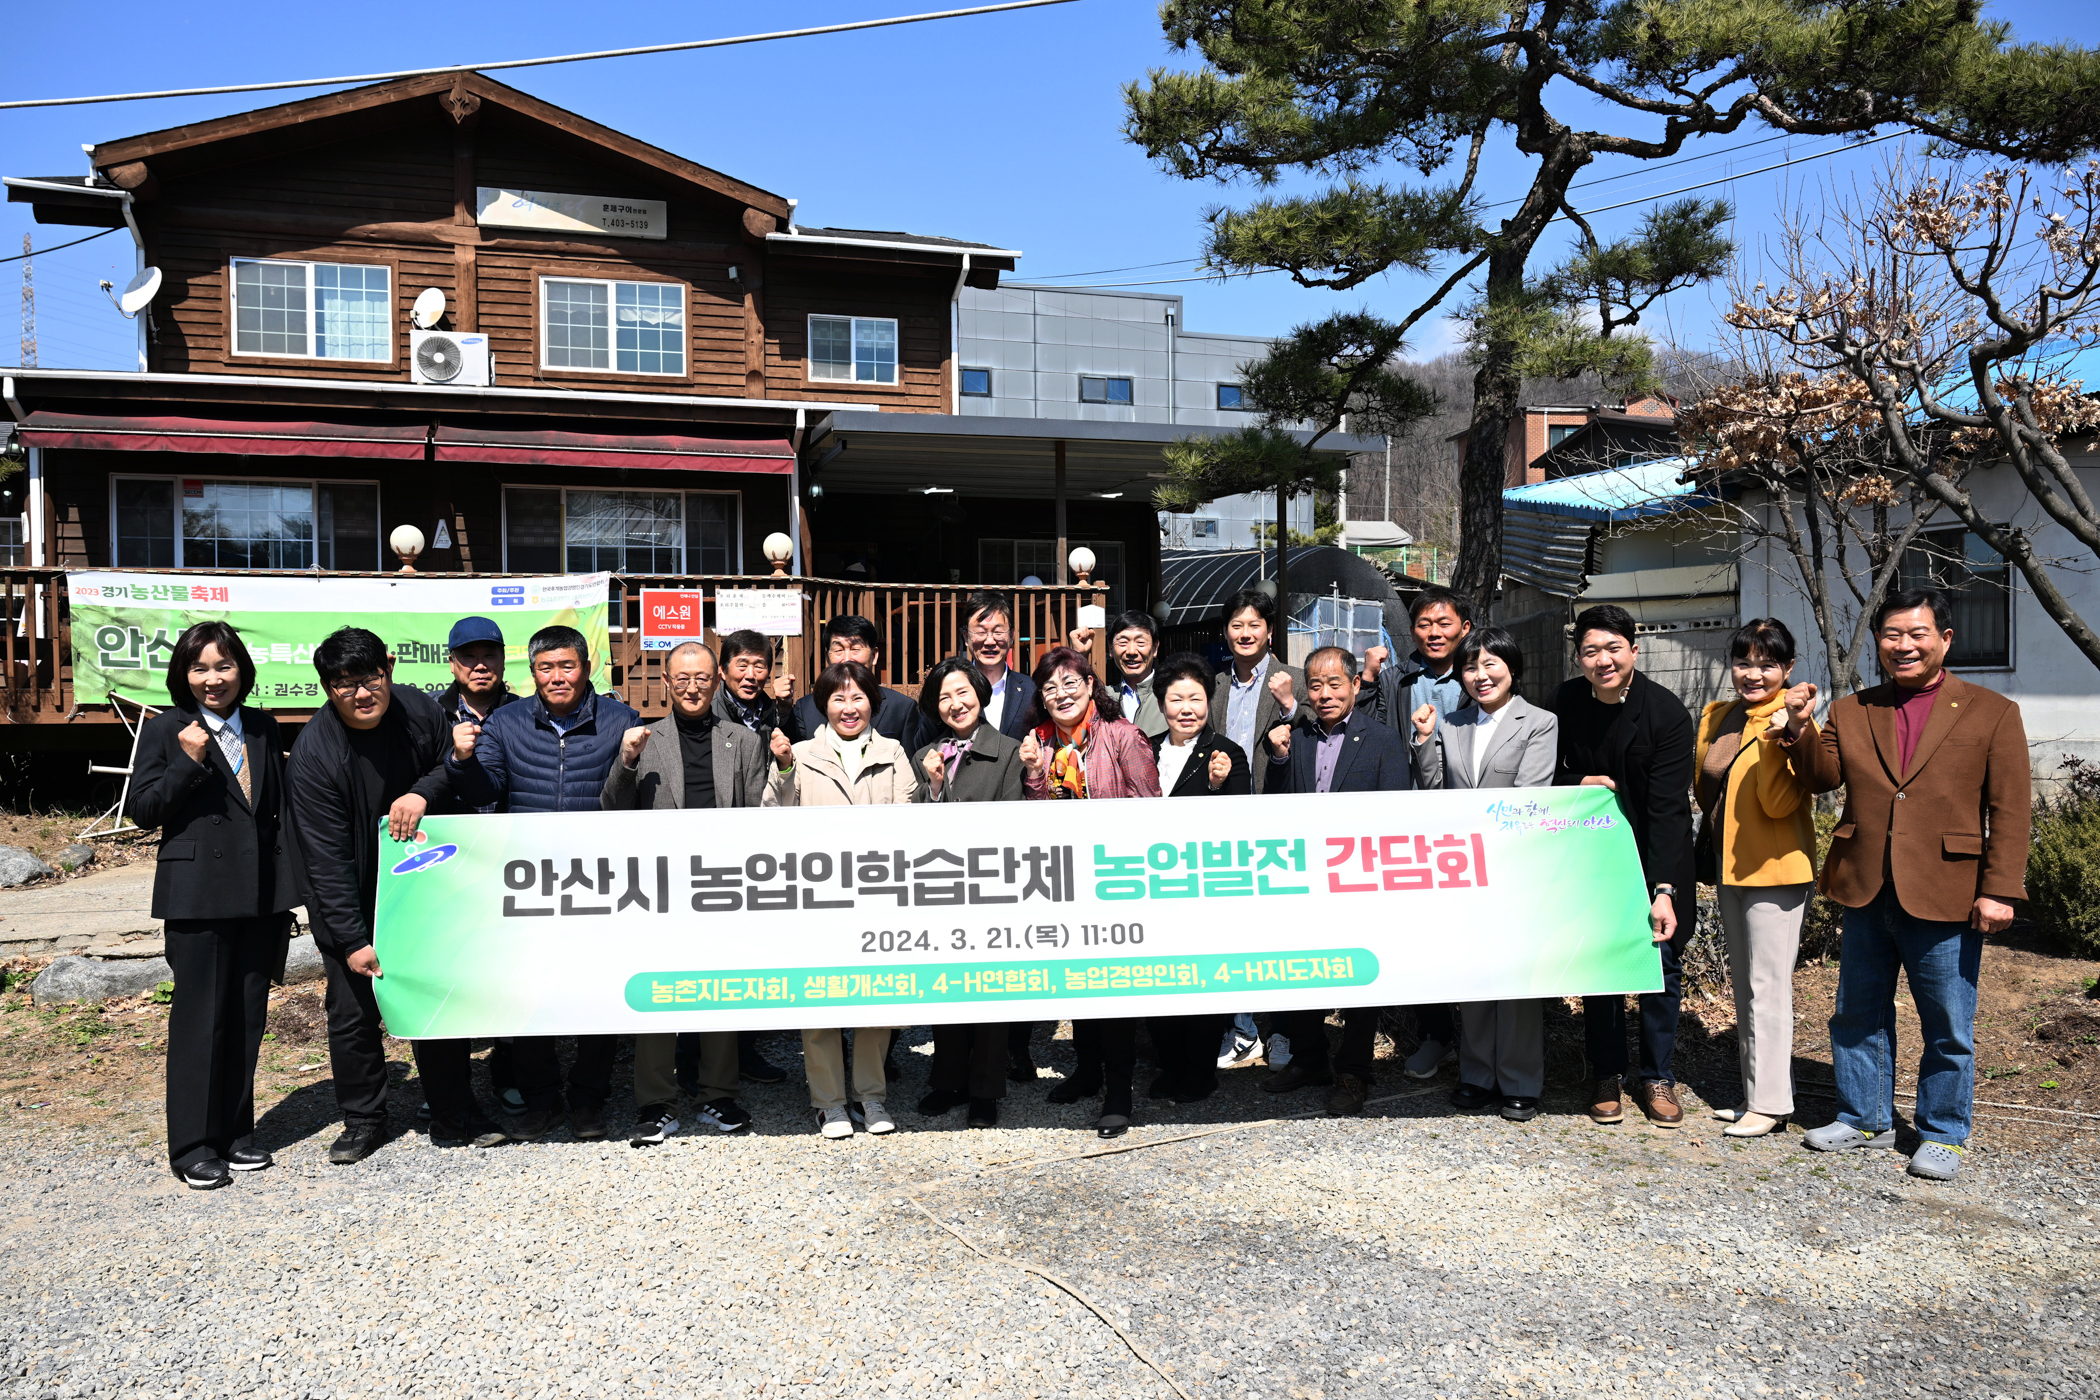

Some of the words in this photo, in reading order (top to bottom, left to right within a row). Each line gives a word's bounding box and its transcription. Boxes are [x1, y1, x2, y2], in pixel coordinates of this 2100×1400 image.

[602, 217, 649, 229] T.403-5139
[75, 587, 99, 596] 2023
[101, 586, 128, 598] 경기
[130, 584, 189, 602] 농산물
[190, 585, 229, 603] 축제
[653, 605, 691, 620] 에스원
[643, 640, 672, 649] SECOM
[274, 683, 318, 696] 권수경
[1582, 814, 1617, 830] 안산
[502, 855, 669, 918] 안산시
[690, 845, 1075, 913] 농업인학습단체
[1093, 838, 1310, 901] 농업발전
[1325, 833, 1489, 893] 간담회
[861, 930, 939, 953] 2024.
[950, 928, 976, 951] 3.
[986, 923, 1070, 949] 21.(목)
[1081, 922, 1145, 946] 11:00
[652, 976, 796, 1003] 농촌지도자회,
[804, 972, 924, 998] 생활개선회,
[931, 967, 1057, 994] 4-H연합회,
[1064, 963, 1207, 990] 농업경영인회,
[1213, 956, 1355, 984] 4-H지도자회
